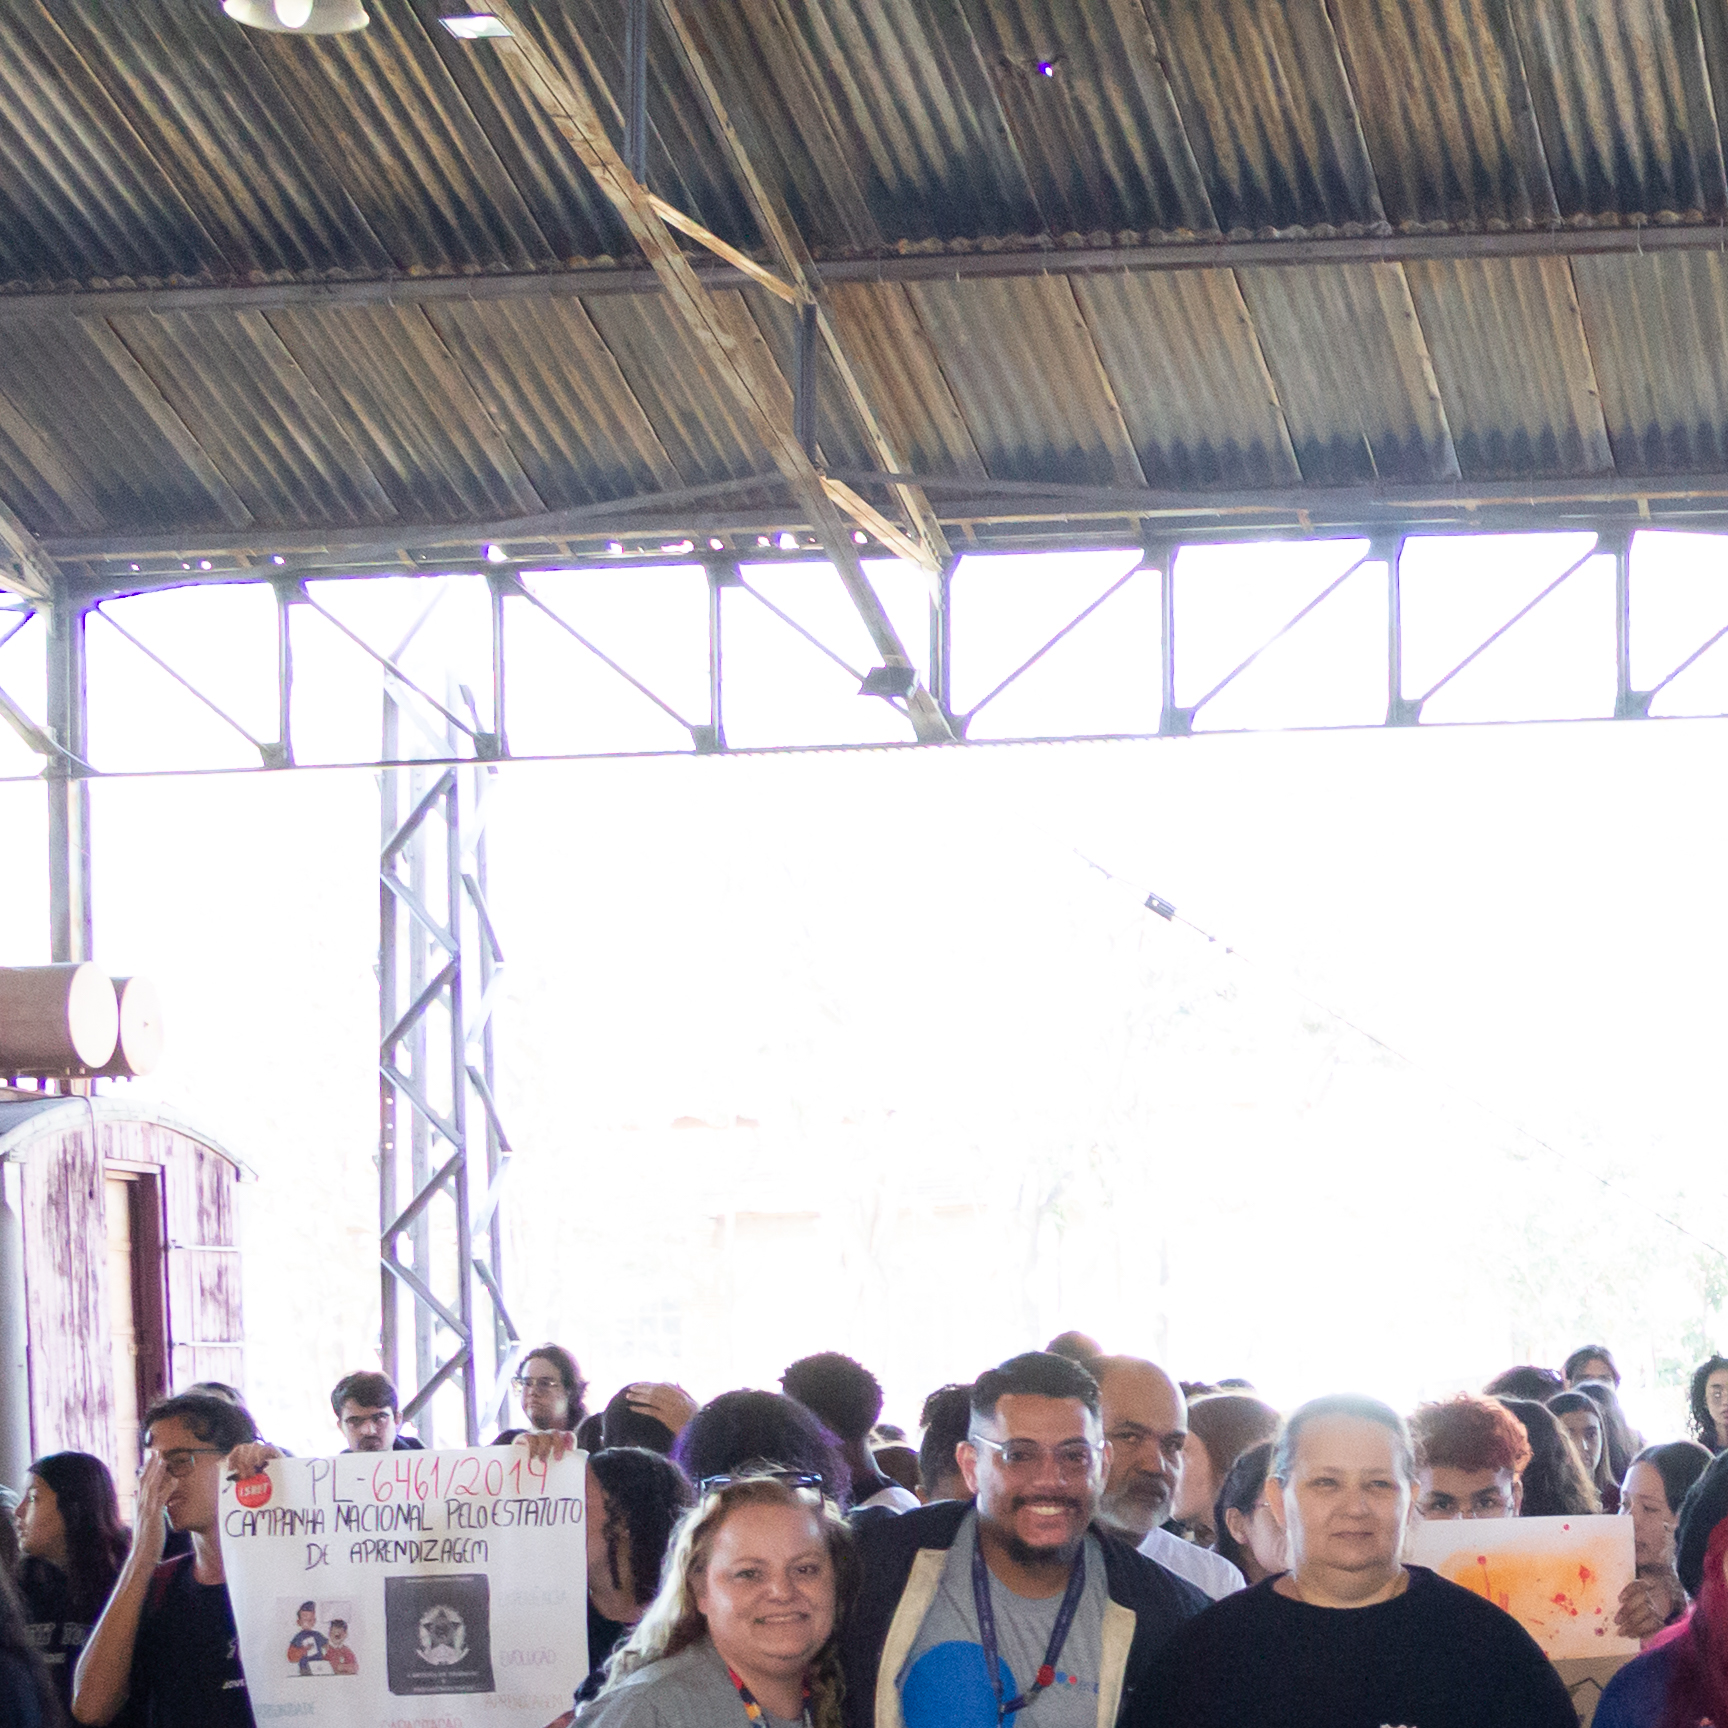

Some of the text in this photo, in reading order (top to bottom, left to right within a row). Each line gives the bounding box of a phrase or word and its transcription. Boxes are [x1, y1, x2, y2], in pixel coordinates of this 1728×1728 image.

[225, 1498, 583, 1538] CAMPANHA NACIONAL PELO ESTATUTO
[304, 1537, 489, 1571] DE APRENDIZAGEM
